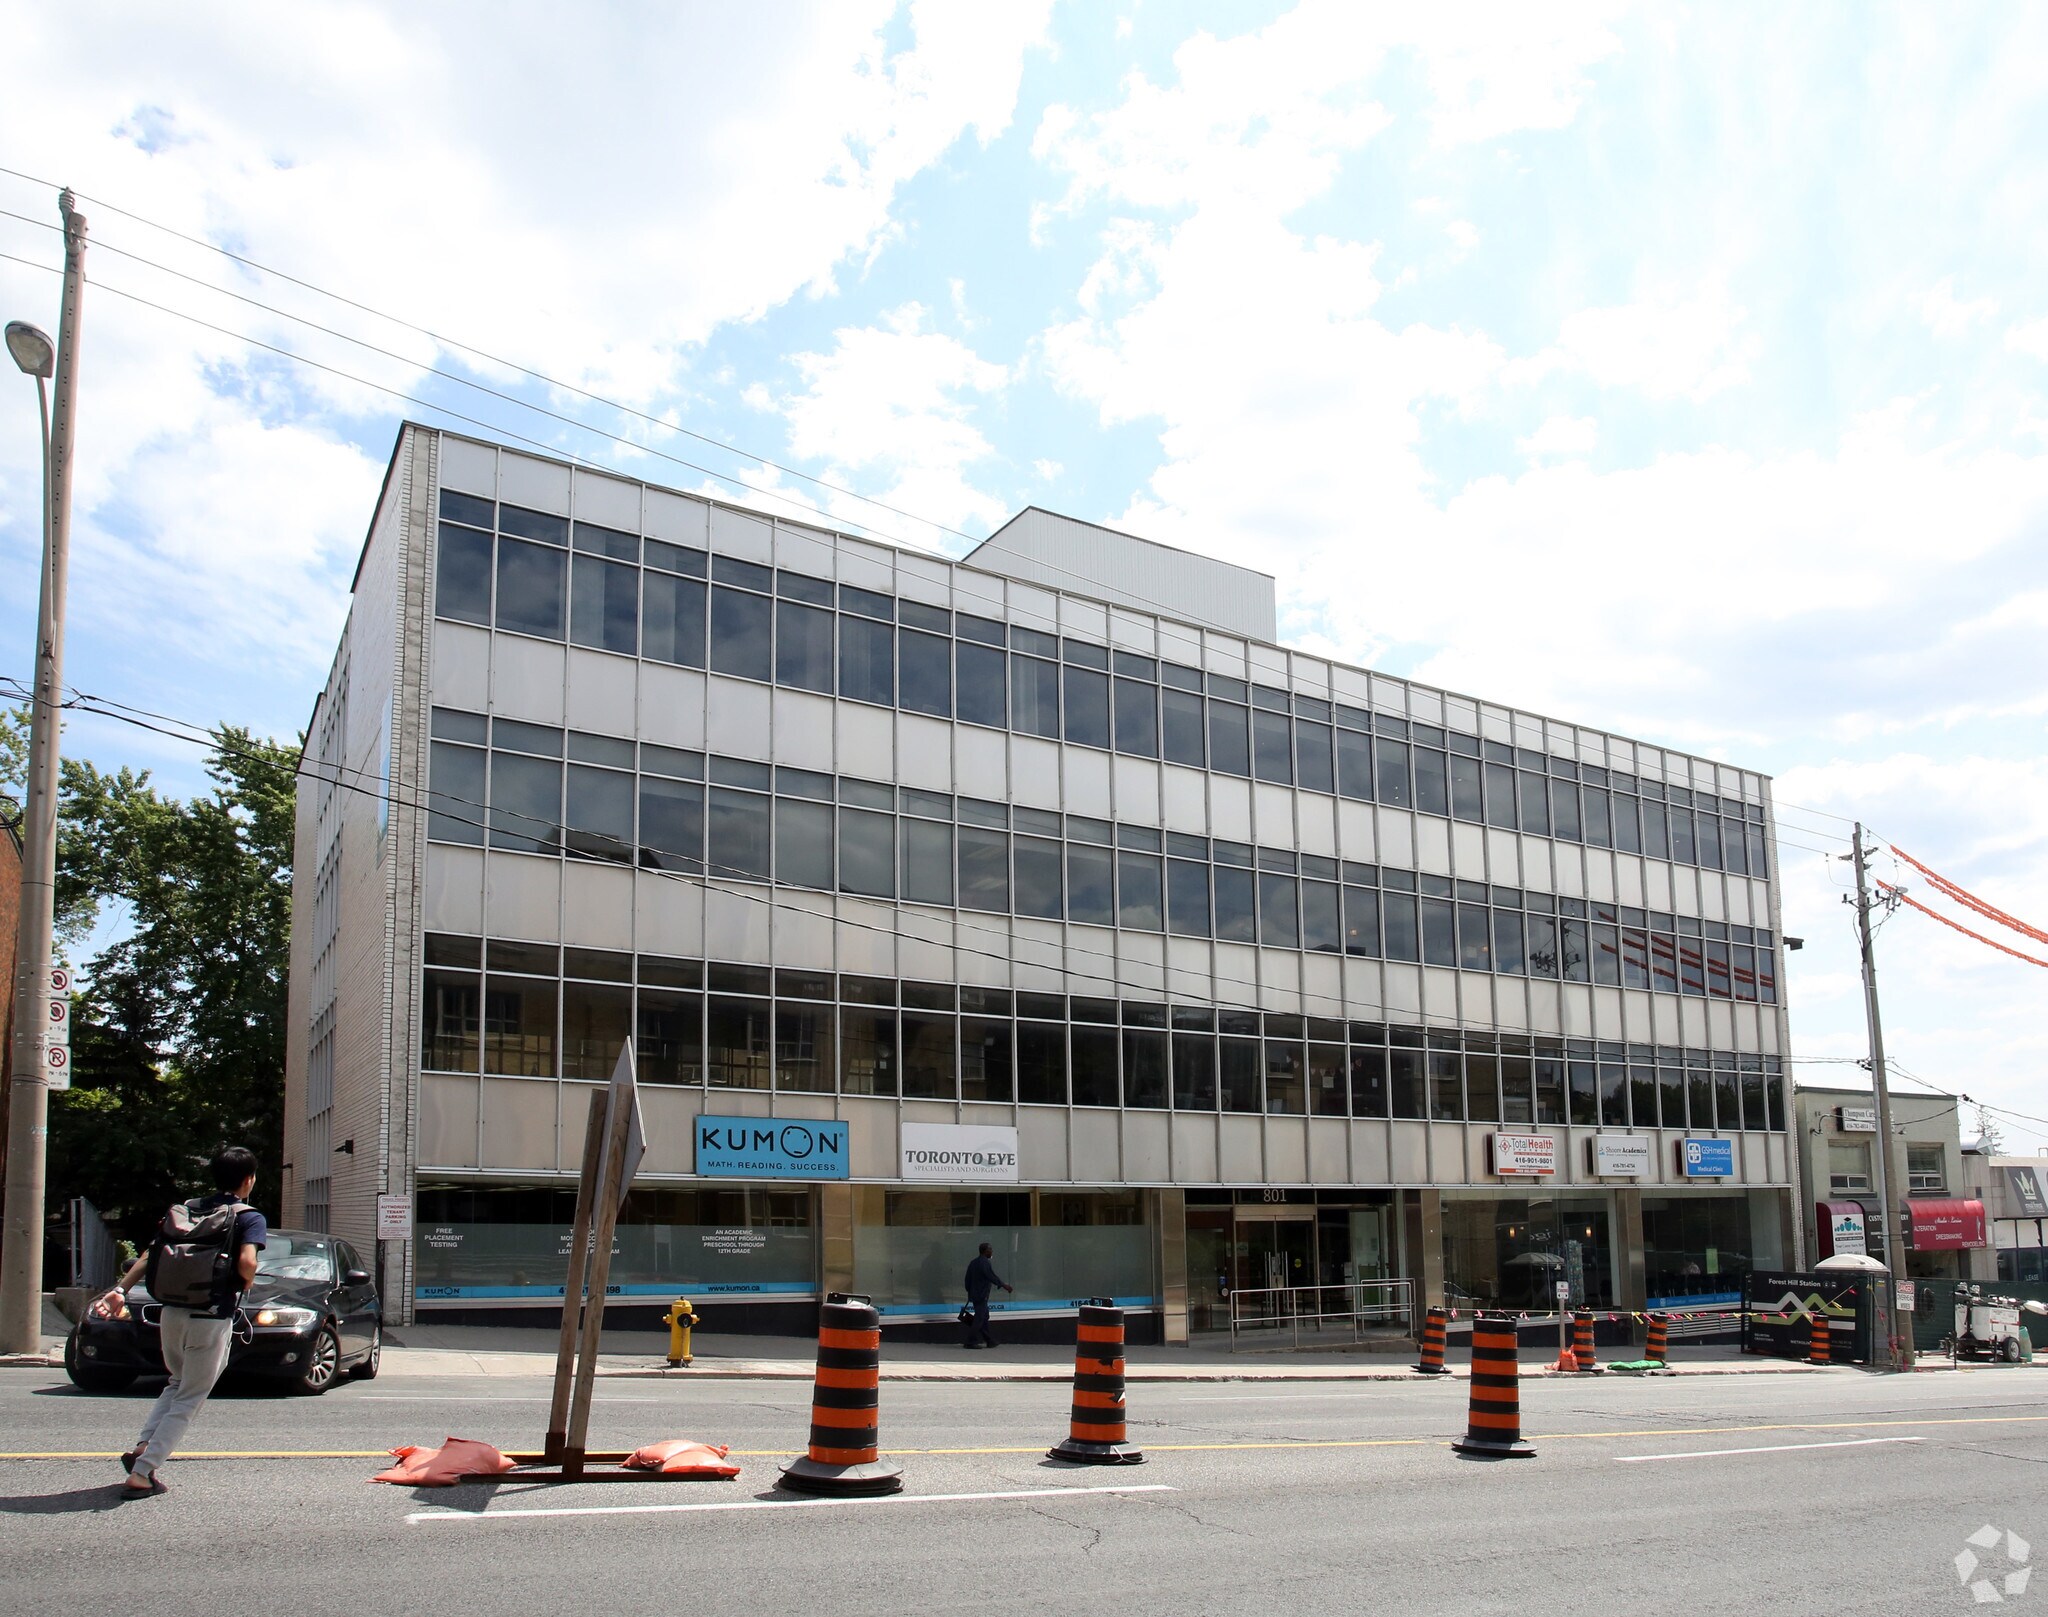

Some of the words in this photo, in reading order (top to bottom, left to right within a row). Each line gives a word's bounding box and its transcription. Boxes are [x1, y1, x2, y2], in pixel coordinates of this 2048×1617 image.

[702, 1125, 839, 1159] KUMON
[905, 1150, 983, 1165] TORONTO
[987, 1153, 1016, 1166] EYE
[737, 1161, 786, 1170] READING.
[790, 1163, 839, 1171] SUCCESS.
[1263, 1188, 1287, 1203] 801
[424, 1286, 460, 1295] KUMON
[707, 1284, 760, 1292] www.kumon.ca
